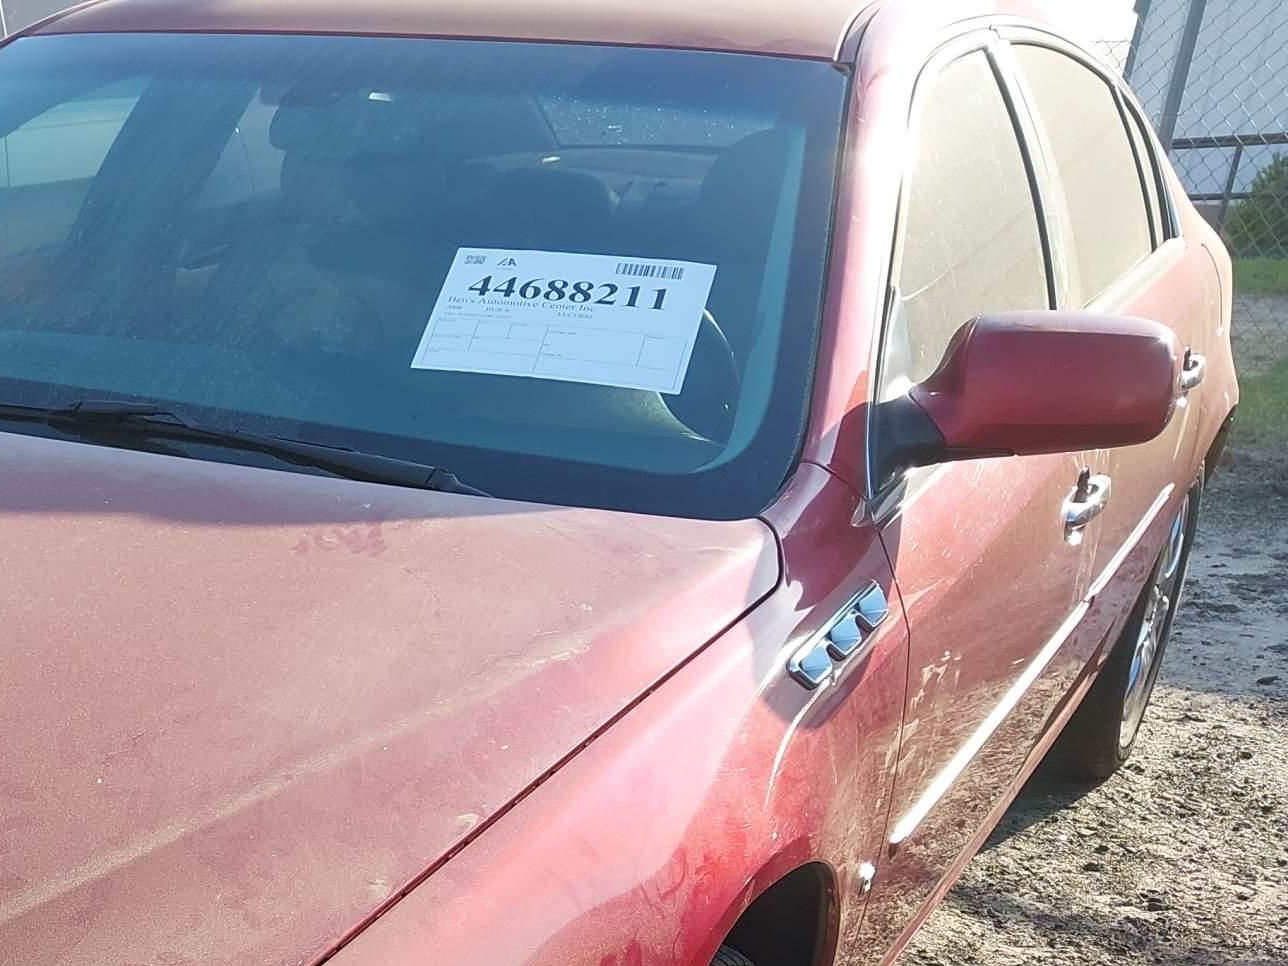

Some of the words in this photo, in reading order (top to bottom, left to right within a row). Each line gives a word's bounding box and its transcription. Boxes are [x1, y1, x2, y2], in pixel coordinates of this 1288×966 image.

[468, 275, 667, 310] 44688211
[477, 297, 539, 308] Automotive
[541, 301, 576, 311] Center
